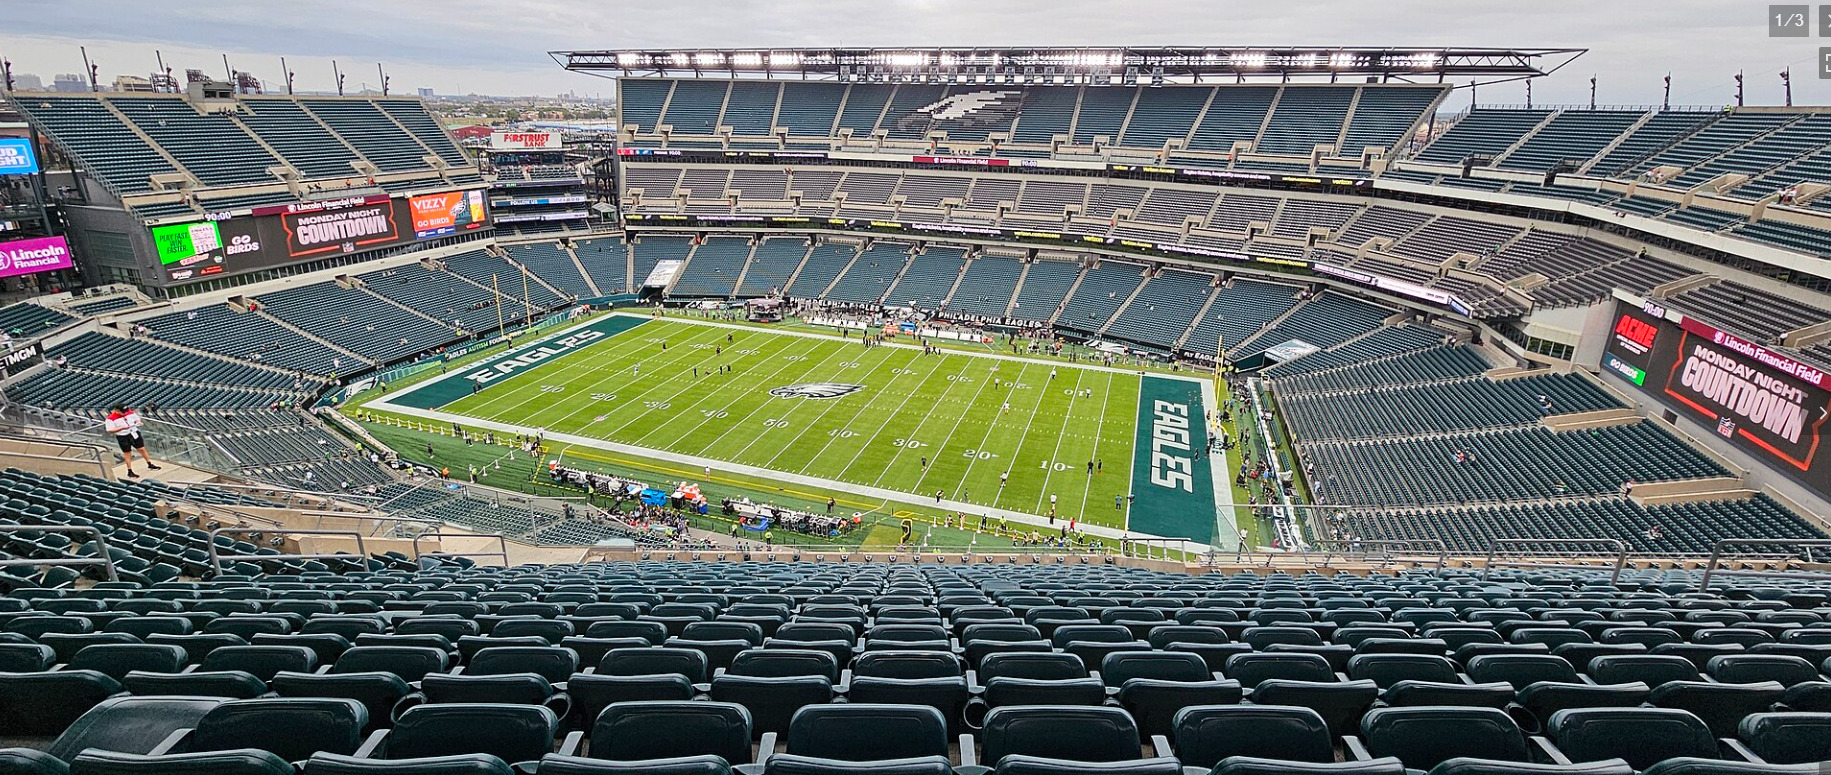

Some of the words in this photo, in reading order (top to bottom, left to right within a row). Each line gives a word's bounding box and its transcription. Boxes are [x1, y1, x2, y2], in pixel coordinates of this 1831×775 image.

[0, 147, 18, 157] UD
[0, 156, 26, 166] GHT
[412, 196, 447, 210] VIZZY
[205, 211, 231, 221] 90:00
[297, 212, 347, 226] MONDAY
[348, 208, 381, 219] NIGHT
[429, 217, 450, 226] BIRDS
[296, 214, 388, 246] COUNTDOWN
[231, 234, 251, 245] GO
[11, 245, 65, 260] Lincoln
[226, 241, 260, 255] BIRDS
[14, 255, 60, 269] Financial
[1643, 302, 1665, 318] 90:00
[938, 312, 1001, 324] PHILADELPHIA
[1005, 318, 1041, 328] EAGLES
[1615, 314, 1658, 349] ACME
[0, 345, 36, 369] ETMGM
[449, 348, 468, 359] AGLES
[468, 342, 489, 353] AUTISM
[464, 329, 606, 384] EAGLES
[1610, 358, 1620, 369] GO
[1724, 336, 1755, 357] Lincoln
[1753, 347, 1795, 375] Financial
[1795, 362, 1824, 385] Field
[1693, 345, 1756, 380] MONDAY
[1754, 372, 1808, 404] NIGHT
[1681, 356, 1808, 444] COUNTDOWN
[762, 418, 789, 429] 50
[827, 428, 853, 438] 40
[892, 438, 920, 449] 30
[1150, 399, 1193, 494] EAGLES
[963, 449, 991, 460] 20
[1039, 460, 1066, 471] 10
